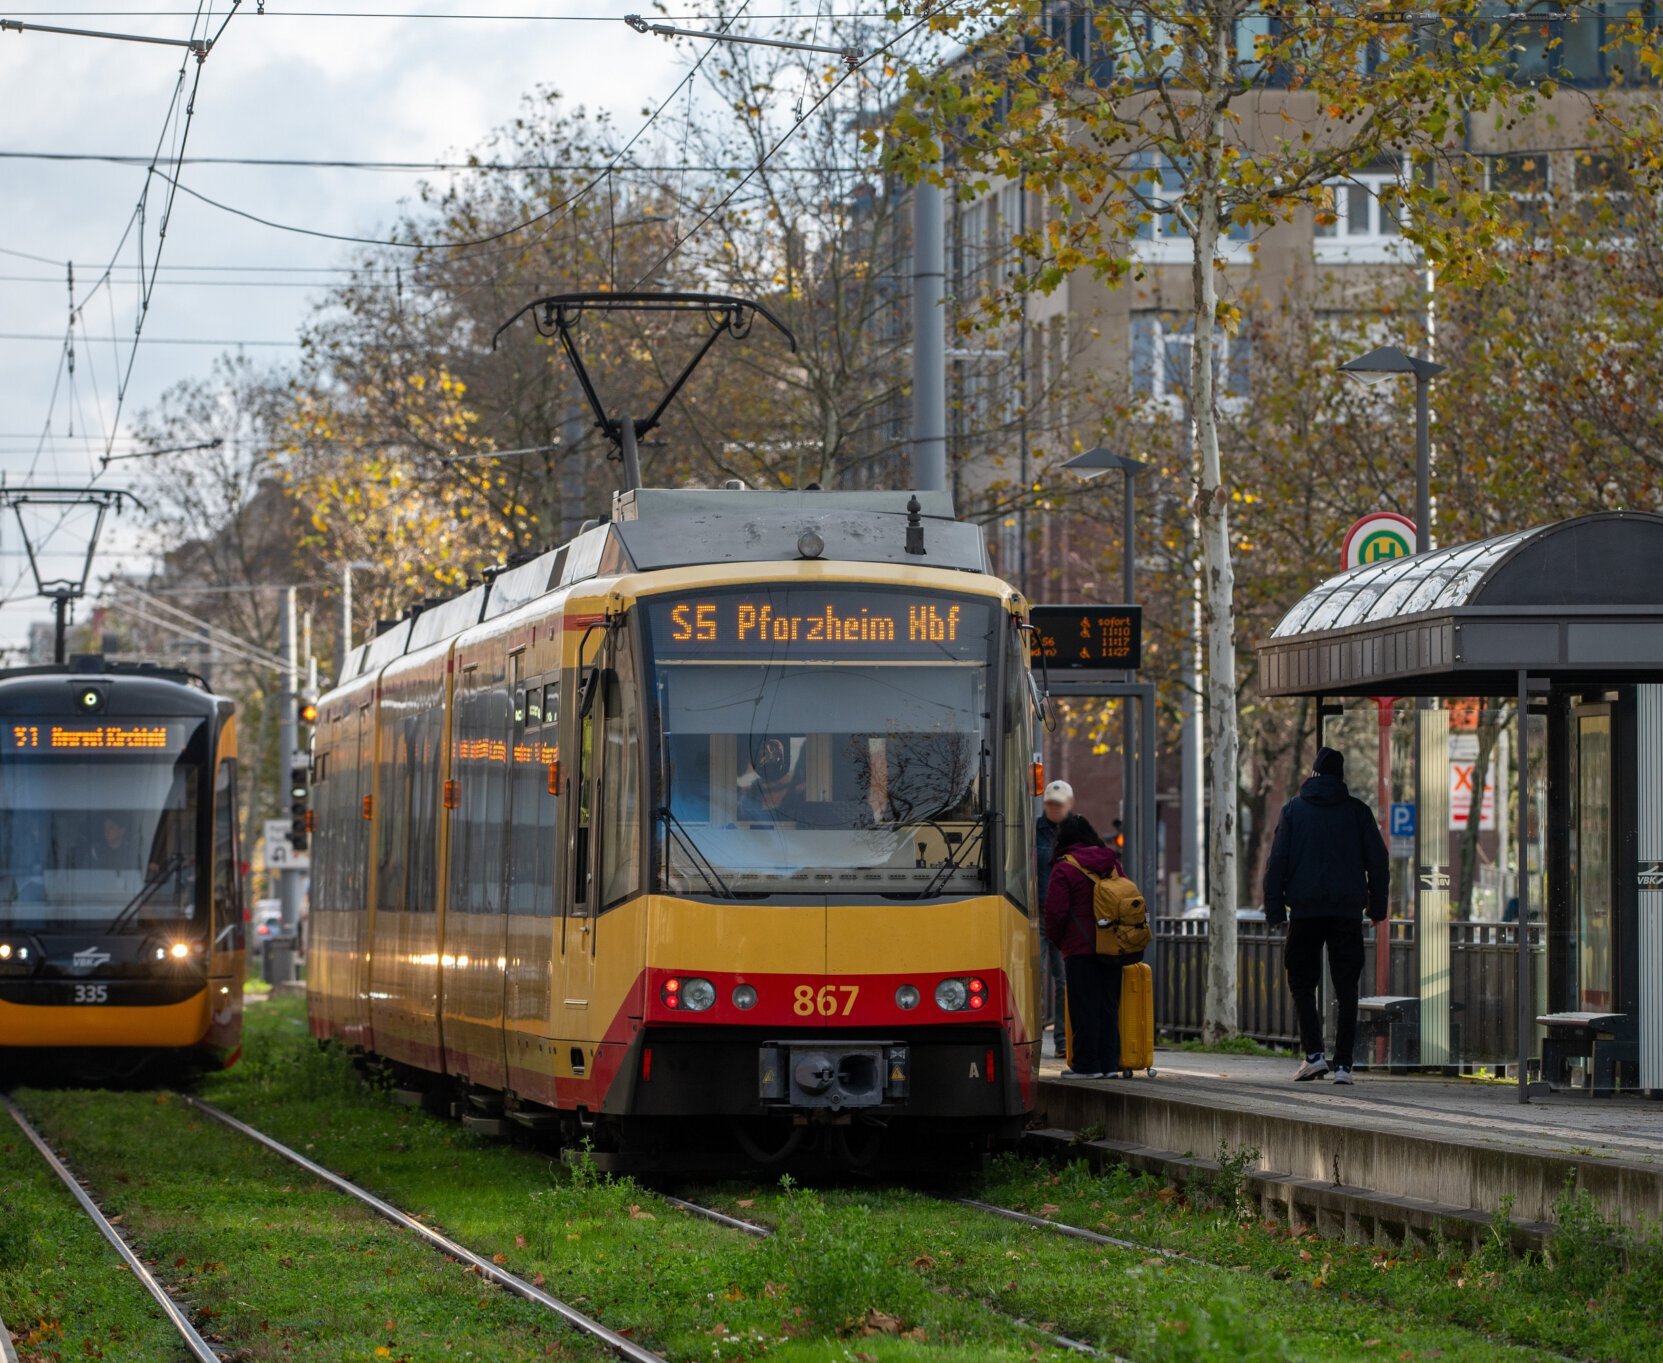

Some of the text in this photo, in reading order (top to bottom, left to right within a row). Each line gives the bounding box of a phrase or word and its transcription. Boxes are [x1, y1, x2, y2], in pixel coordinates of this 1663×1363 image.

[1373, 543, 1396, 561] H
[671, 605, 961, 641] S5 Pforzheim Hbf
[1098, 617, 1131, 626] sofort
[1102, 627, 1131, 636] 11:10
[1102, 637, 1131, 647] 11:17
[1102, 647, 1131, 657] 11:27
[1394, 807, 1410, 834] P
[1637, 876, 1657, 885] VBK
[74, 984, 108, 1003] 335
[793, 984, 860, 1017] 867
[968, 1062, 980, 1079] A
